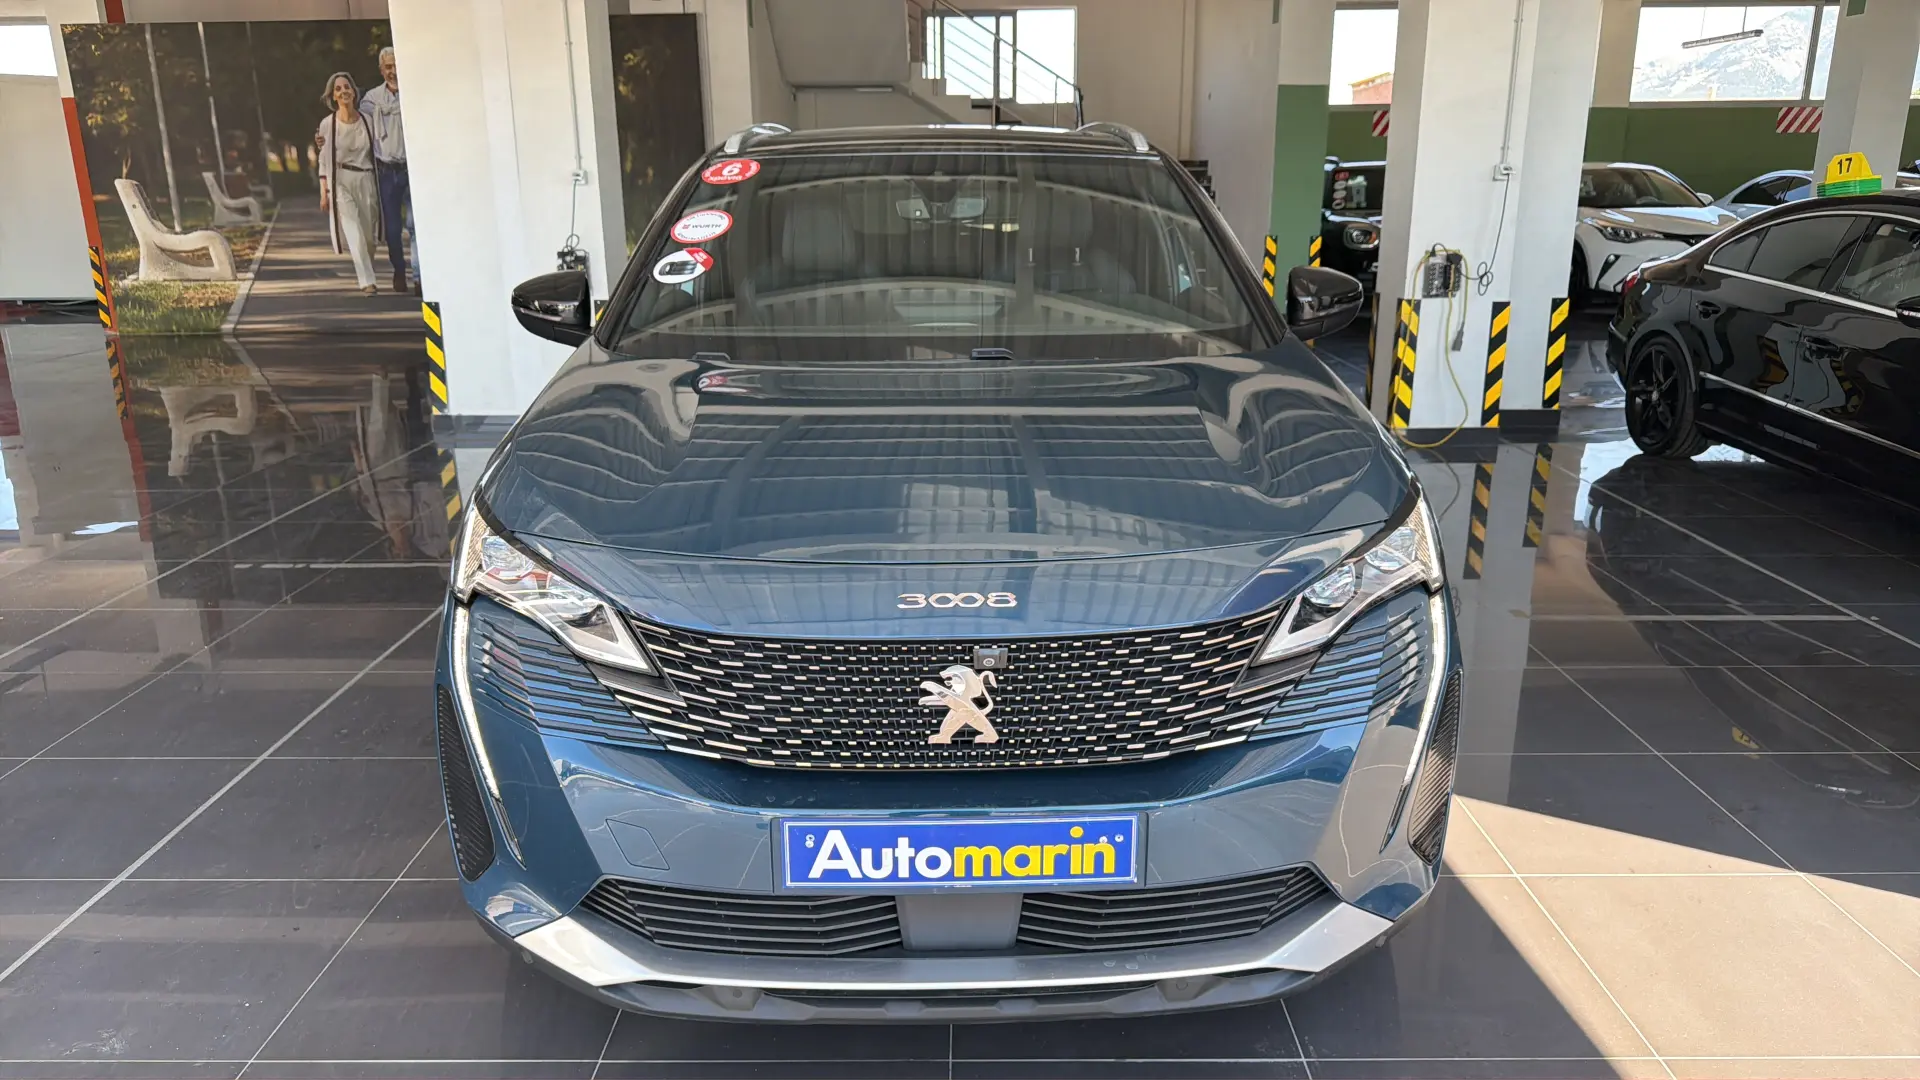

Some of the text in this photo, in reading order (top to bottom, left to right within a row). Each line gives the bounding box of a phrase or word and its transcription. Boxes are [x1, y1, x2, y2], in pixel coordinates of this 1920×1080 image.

[722, 162, 743, 175] 6
[1837, 157, 1852, 174] 17
[897, 592, 1018, 609] 3008
[808, 826, 1115, 879] Automarin
